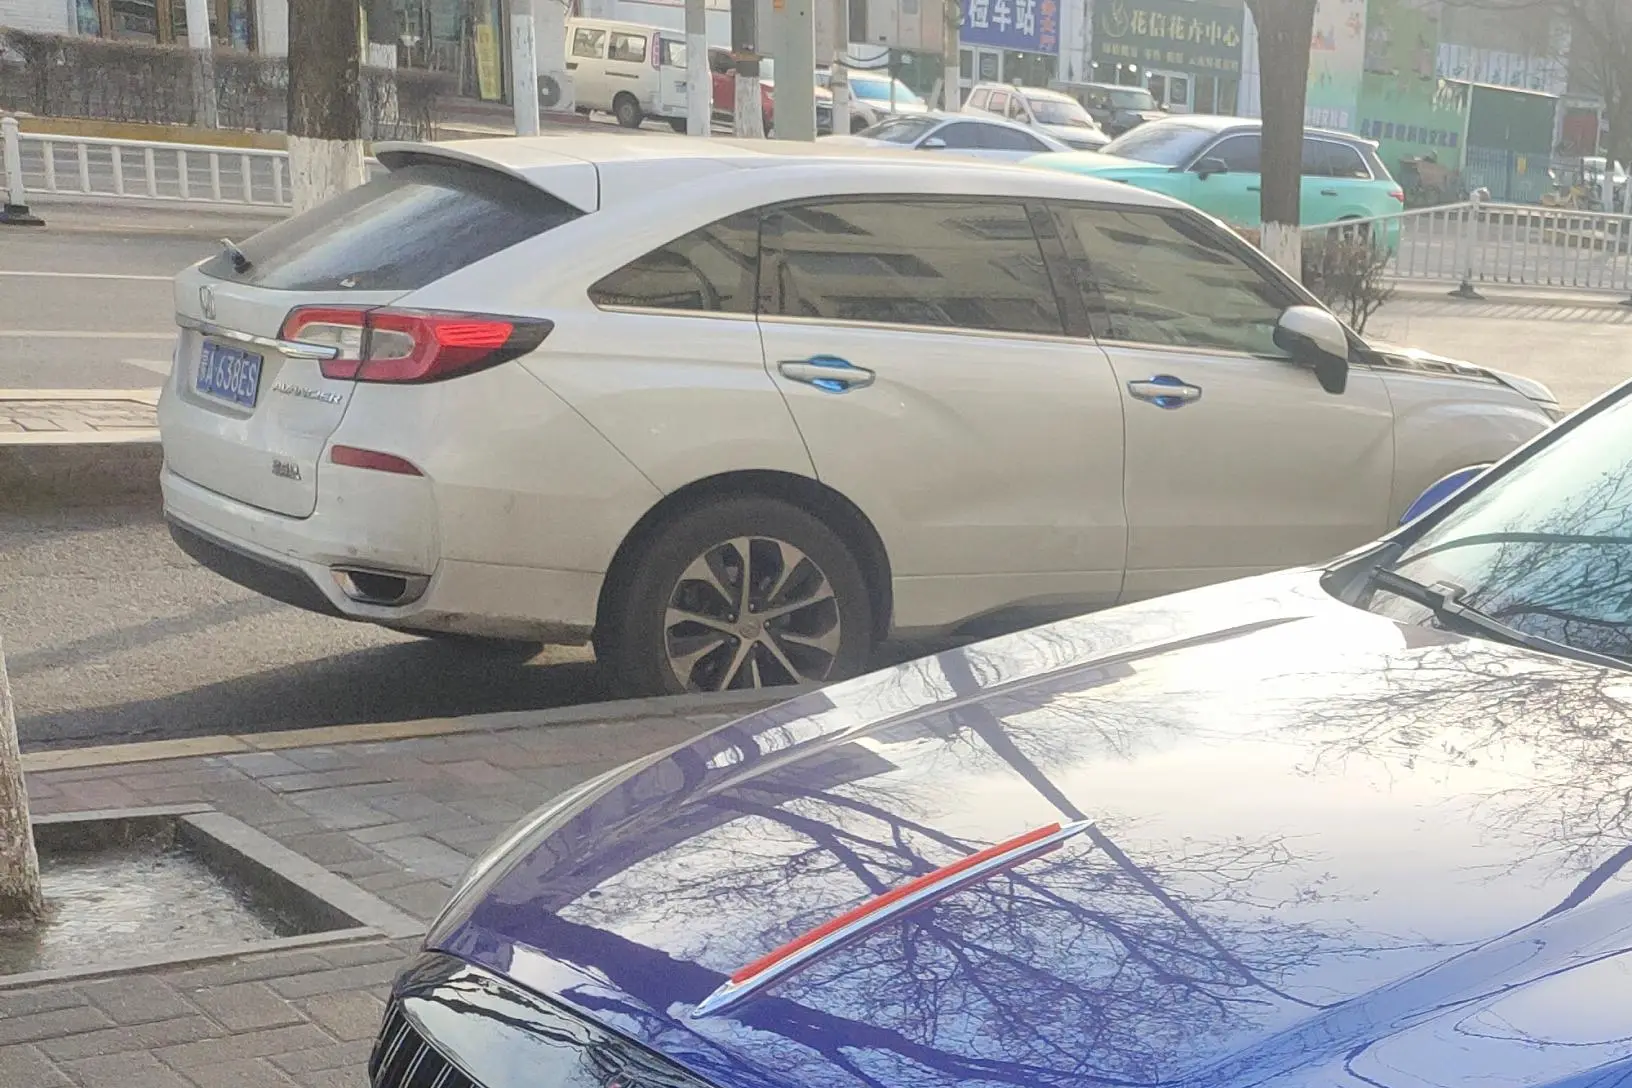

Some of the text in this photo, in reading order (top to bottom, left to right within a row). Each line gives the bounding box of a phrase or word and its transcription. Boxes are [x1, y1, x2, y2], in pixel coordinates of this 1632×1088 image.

[960, 0, 1036, 36] 检车站
[1130, 9, 1240, 47] 花信花卉中心
